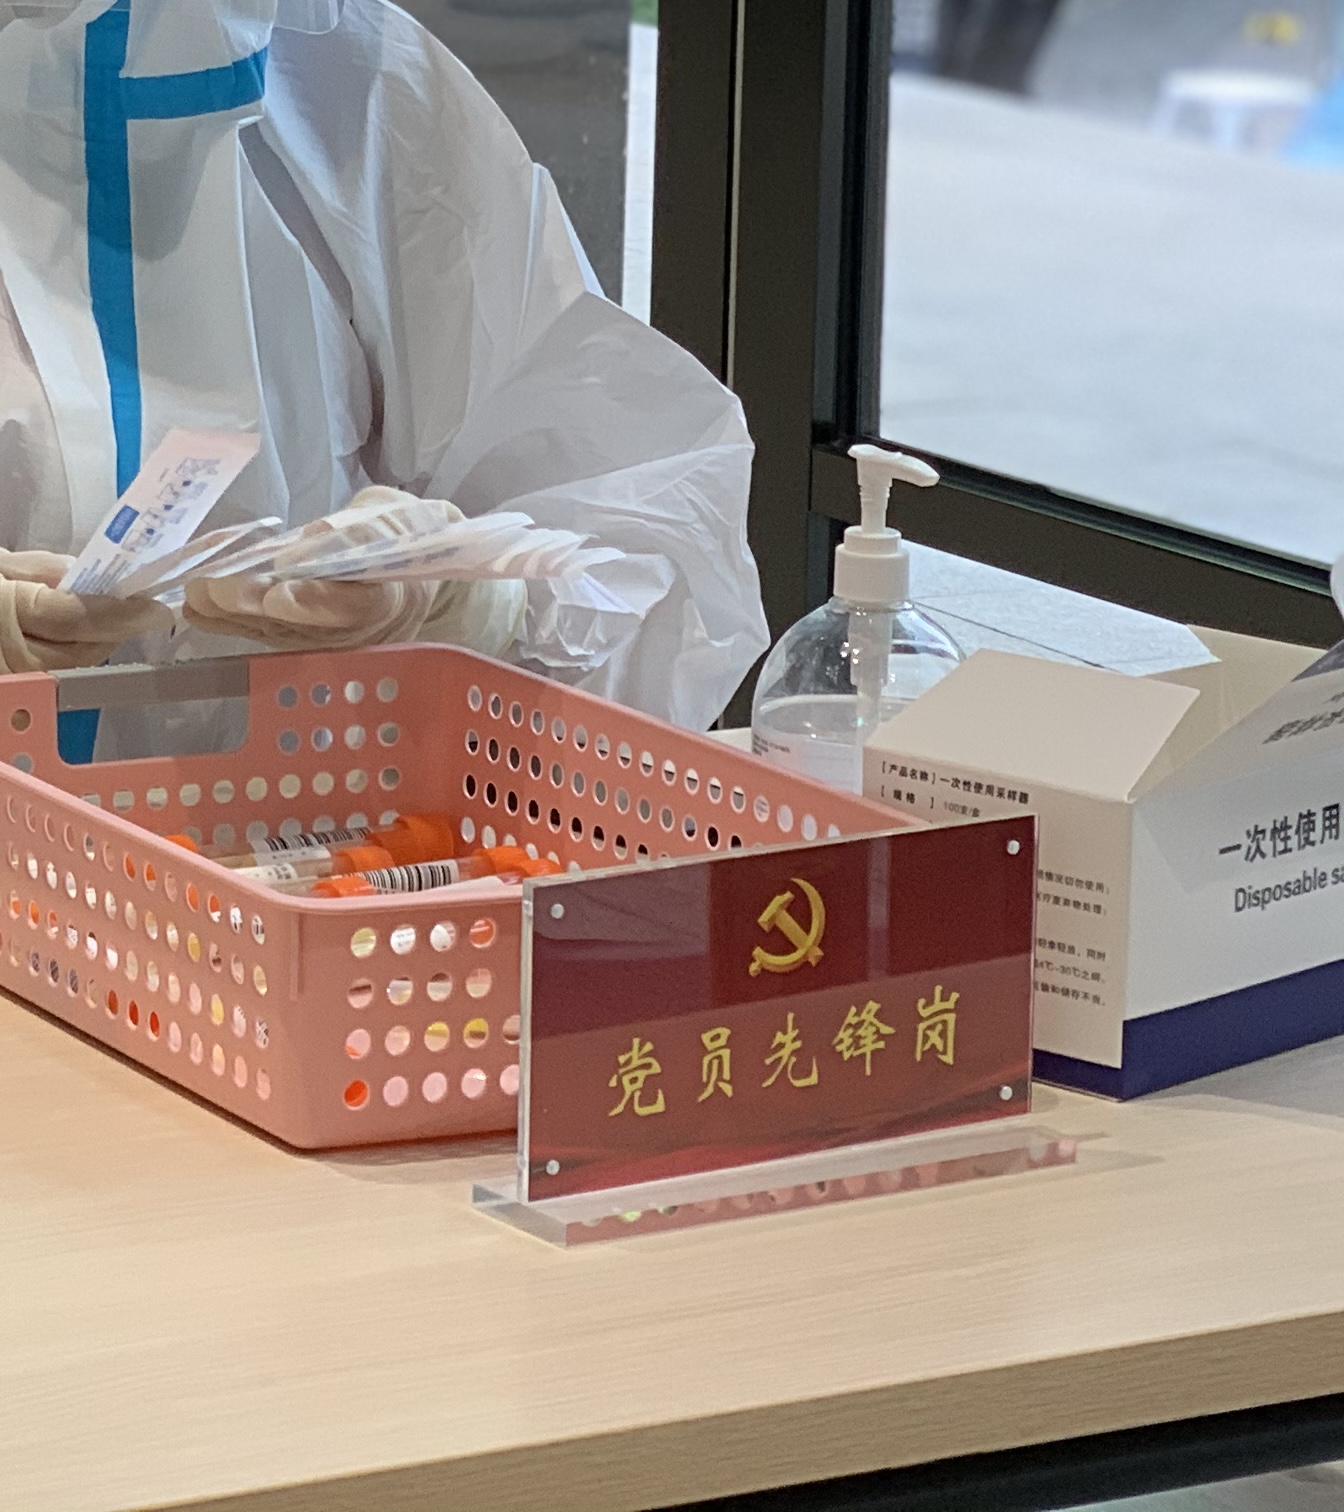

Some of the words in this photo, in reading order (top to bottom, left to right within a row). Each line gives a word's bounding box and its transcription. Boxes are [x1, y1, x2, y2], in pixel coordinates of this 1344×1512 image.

[1218, 802, 1341, 864] 一次性使用
[1233, 867, 1328, 914] Disposable
[608, 984, 960, 1119] 党员先锋岗
